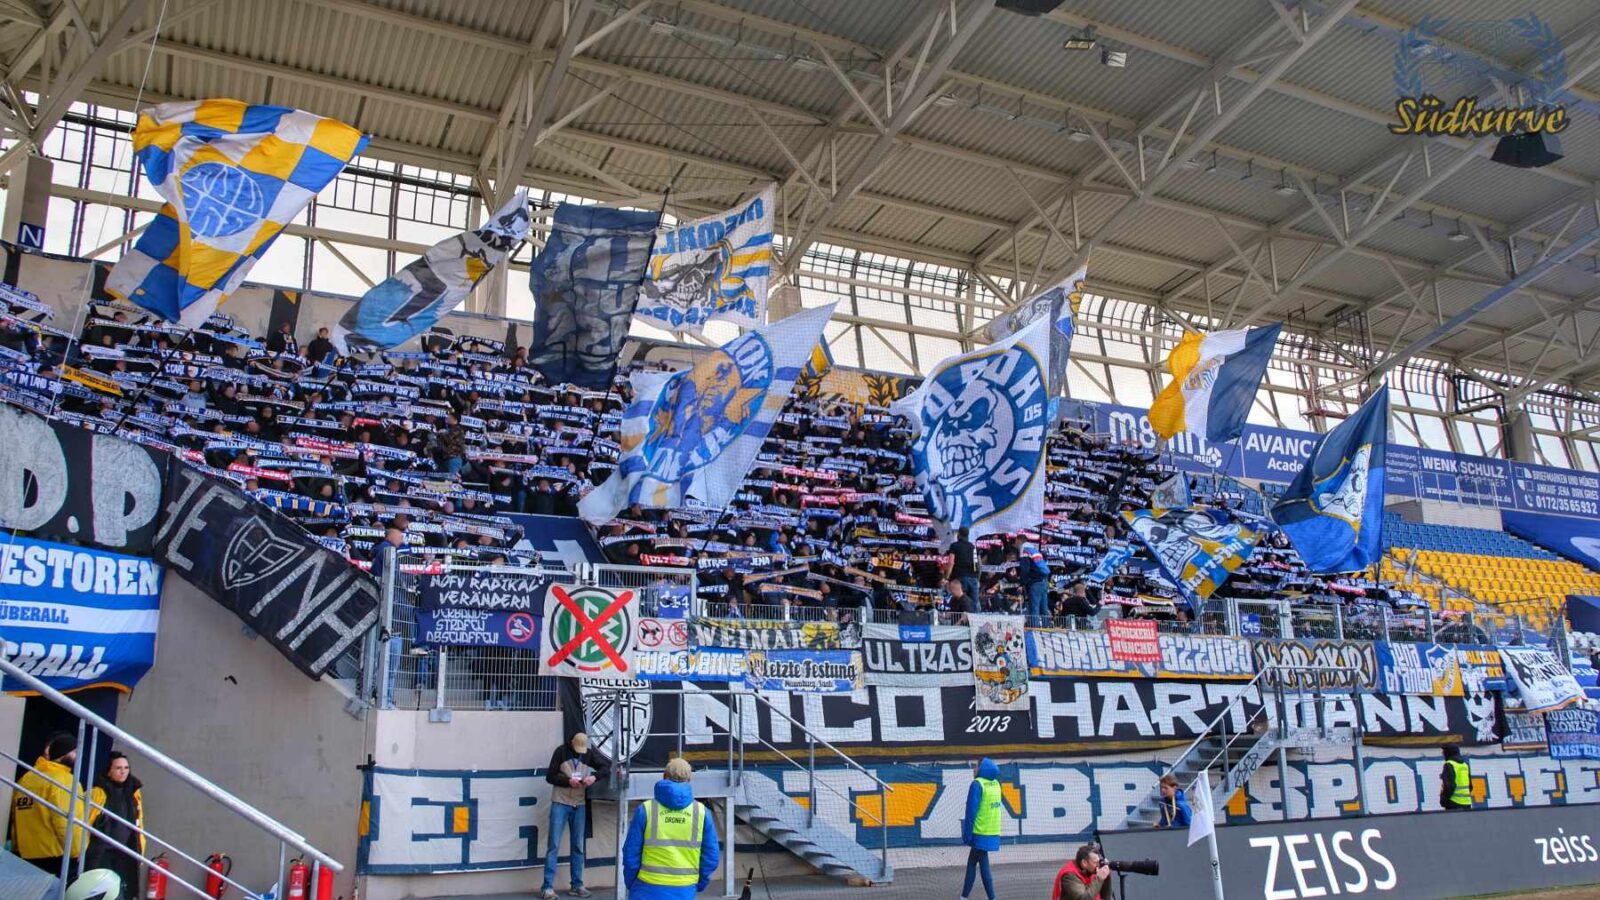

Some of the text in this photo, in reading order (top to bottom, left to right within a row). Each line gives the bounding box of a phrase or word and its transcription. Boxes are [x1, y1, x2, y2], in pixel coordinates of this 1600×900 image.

[21, 224, 43, 248] N
[1246, 432, 1316, 459] AVANC
[1422, 455, 1458, 473] WENK
[750, 556, 770, 567] JENA
[439, 591, 531, 610] VERÄNDERN
[436, 619, 486, 632] STRAFEN
[425, 630, 499, 644] ABSCHAFFEN!
[695, 627, 807, 650] WEIMAR
[864, 637, 973, 674] ULTRAS
[763, 659, 858, 681] Letzte Festung
[684, 680, 945, 745] NICO
[965, 716, 1012, 733] 2013
[1534, 828, 1599, 866] zeiss
[1249, 828, 1398, 900] ZEISS
